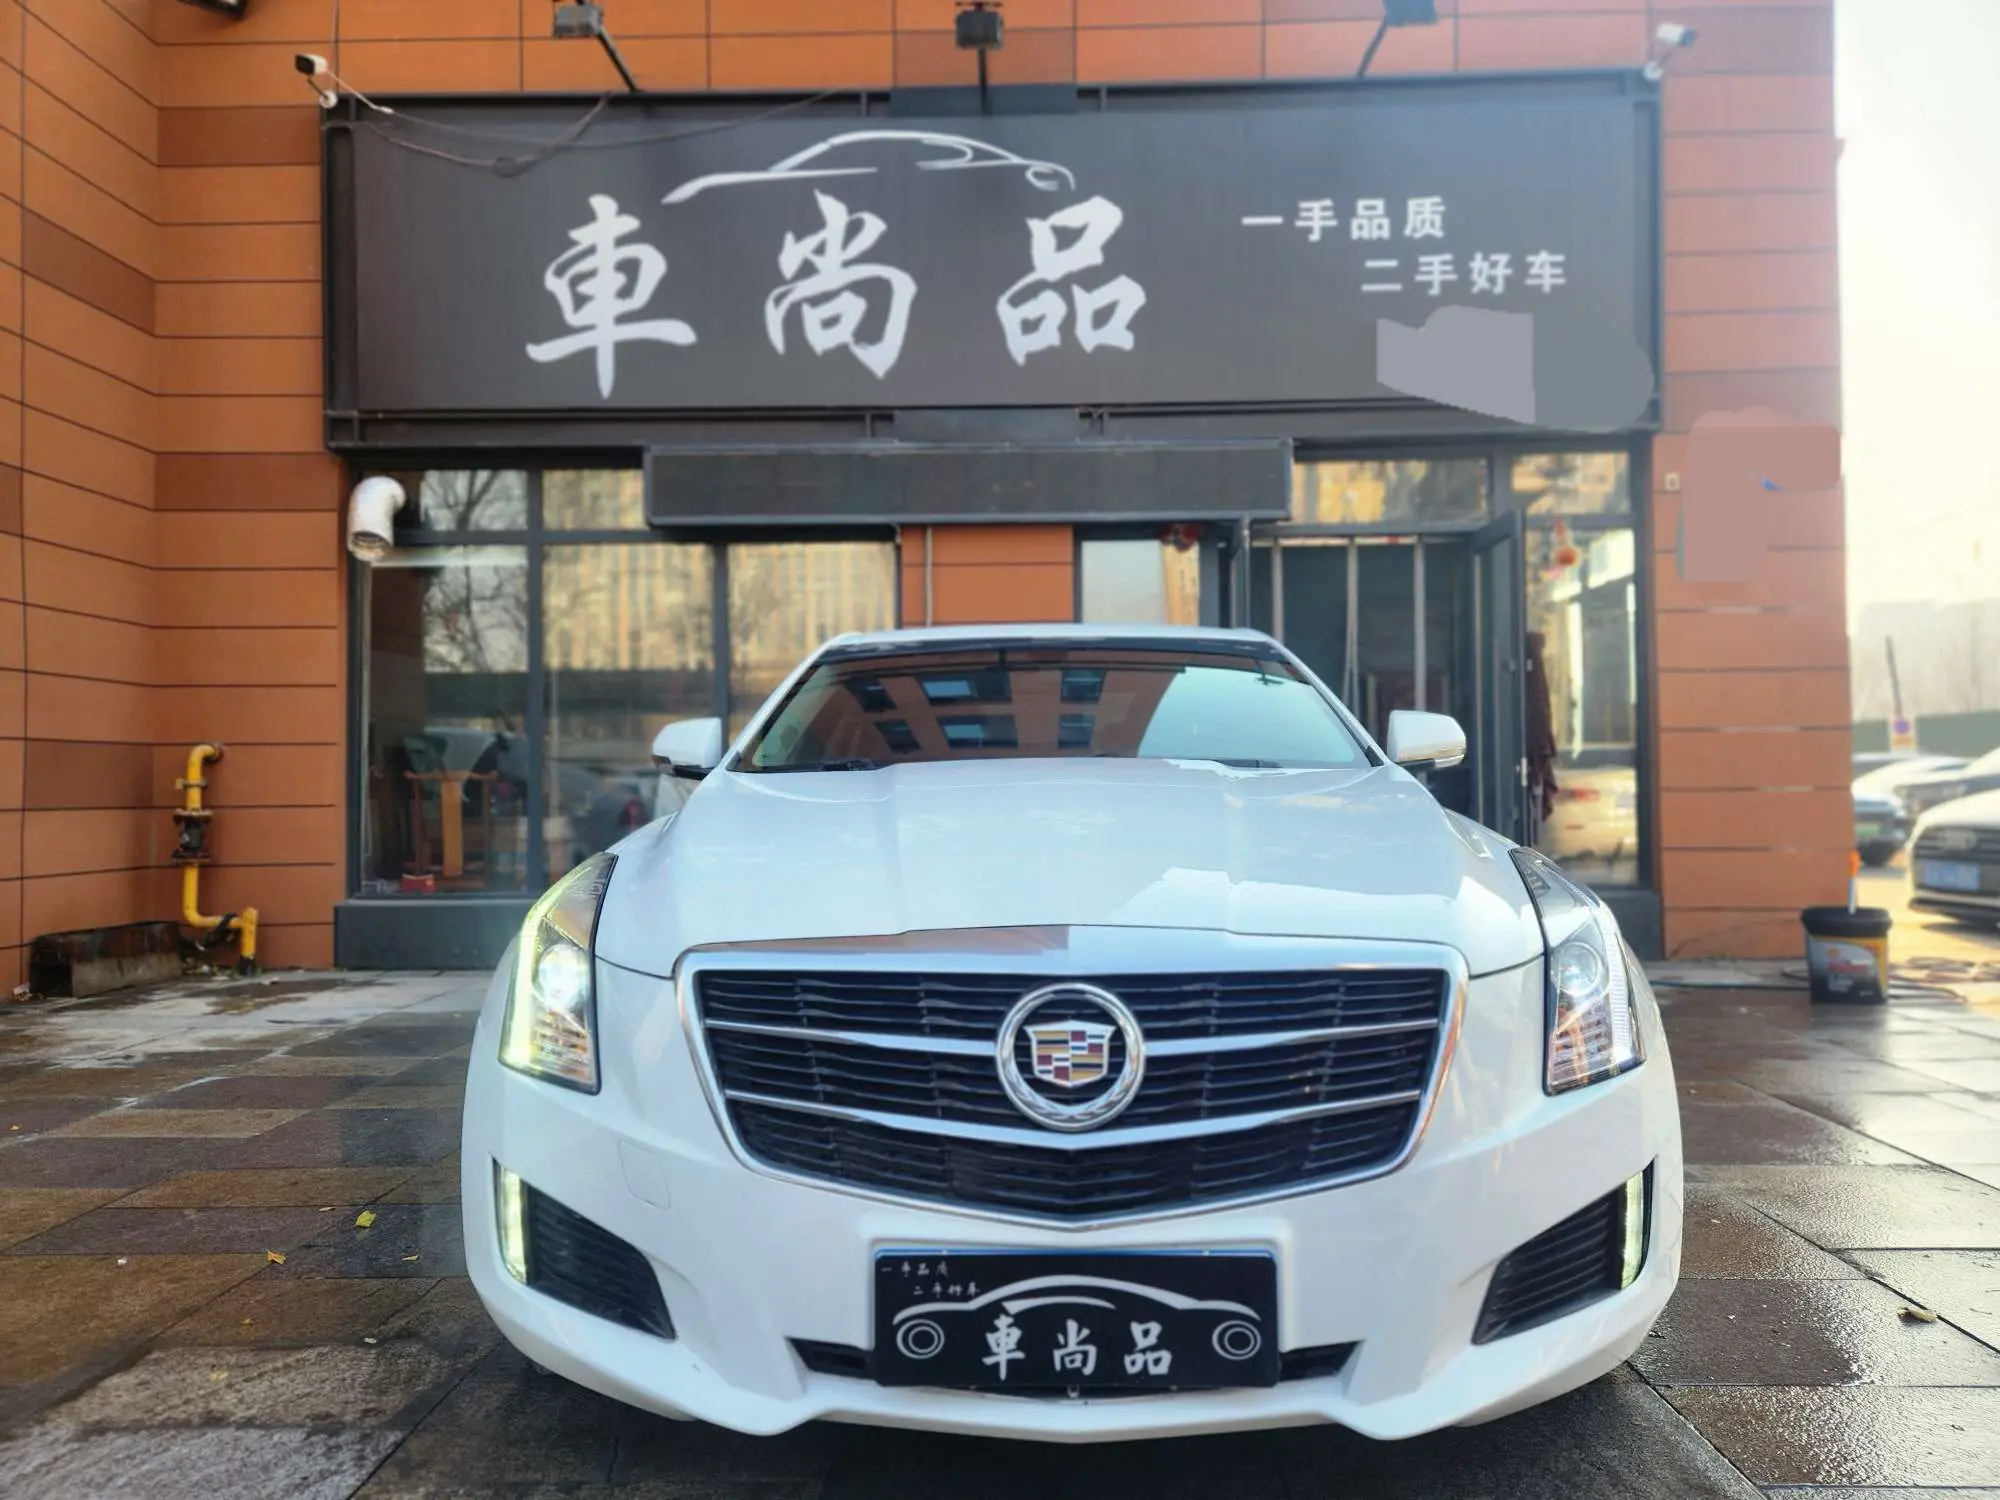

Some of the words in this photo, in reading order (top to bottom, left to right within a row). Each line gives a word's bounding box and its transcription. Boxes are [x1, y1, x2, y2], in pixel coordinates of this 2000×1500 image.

[1242, 195, 1448, 242] 一手品质
[527, 192, 1148, 398] 車尚品
[1361, 250, 1567, 296] 二手好车
[981, 1313, 1173, 1381] 車尚品
